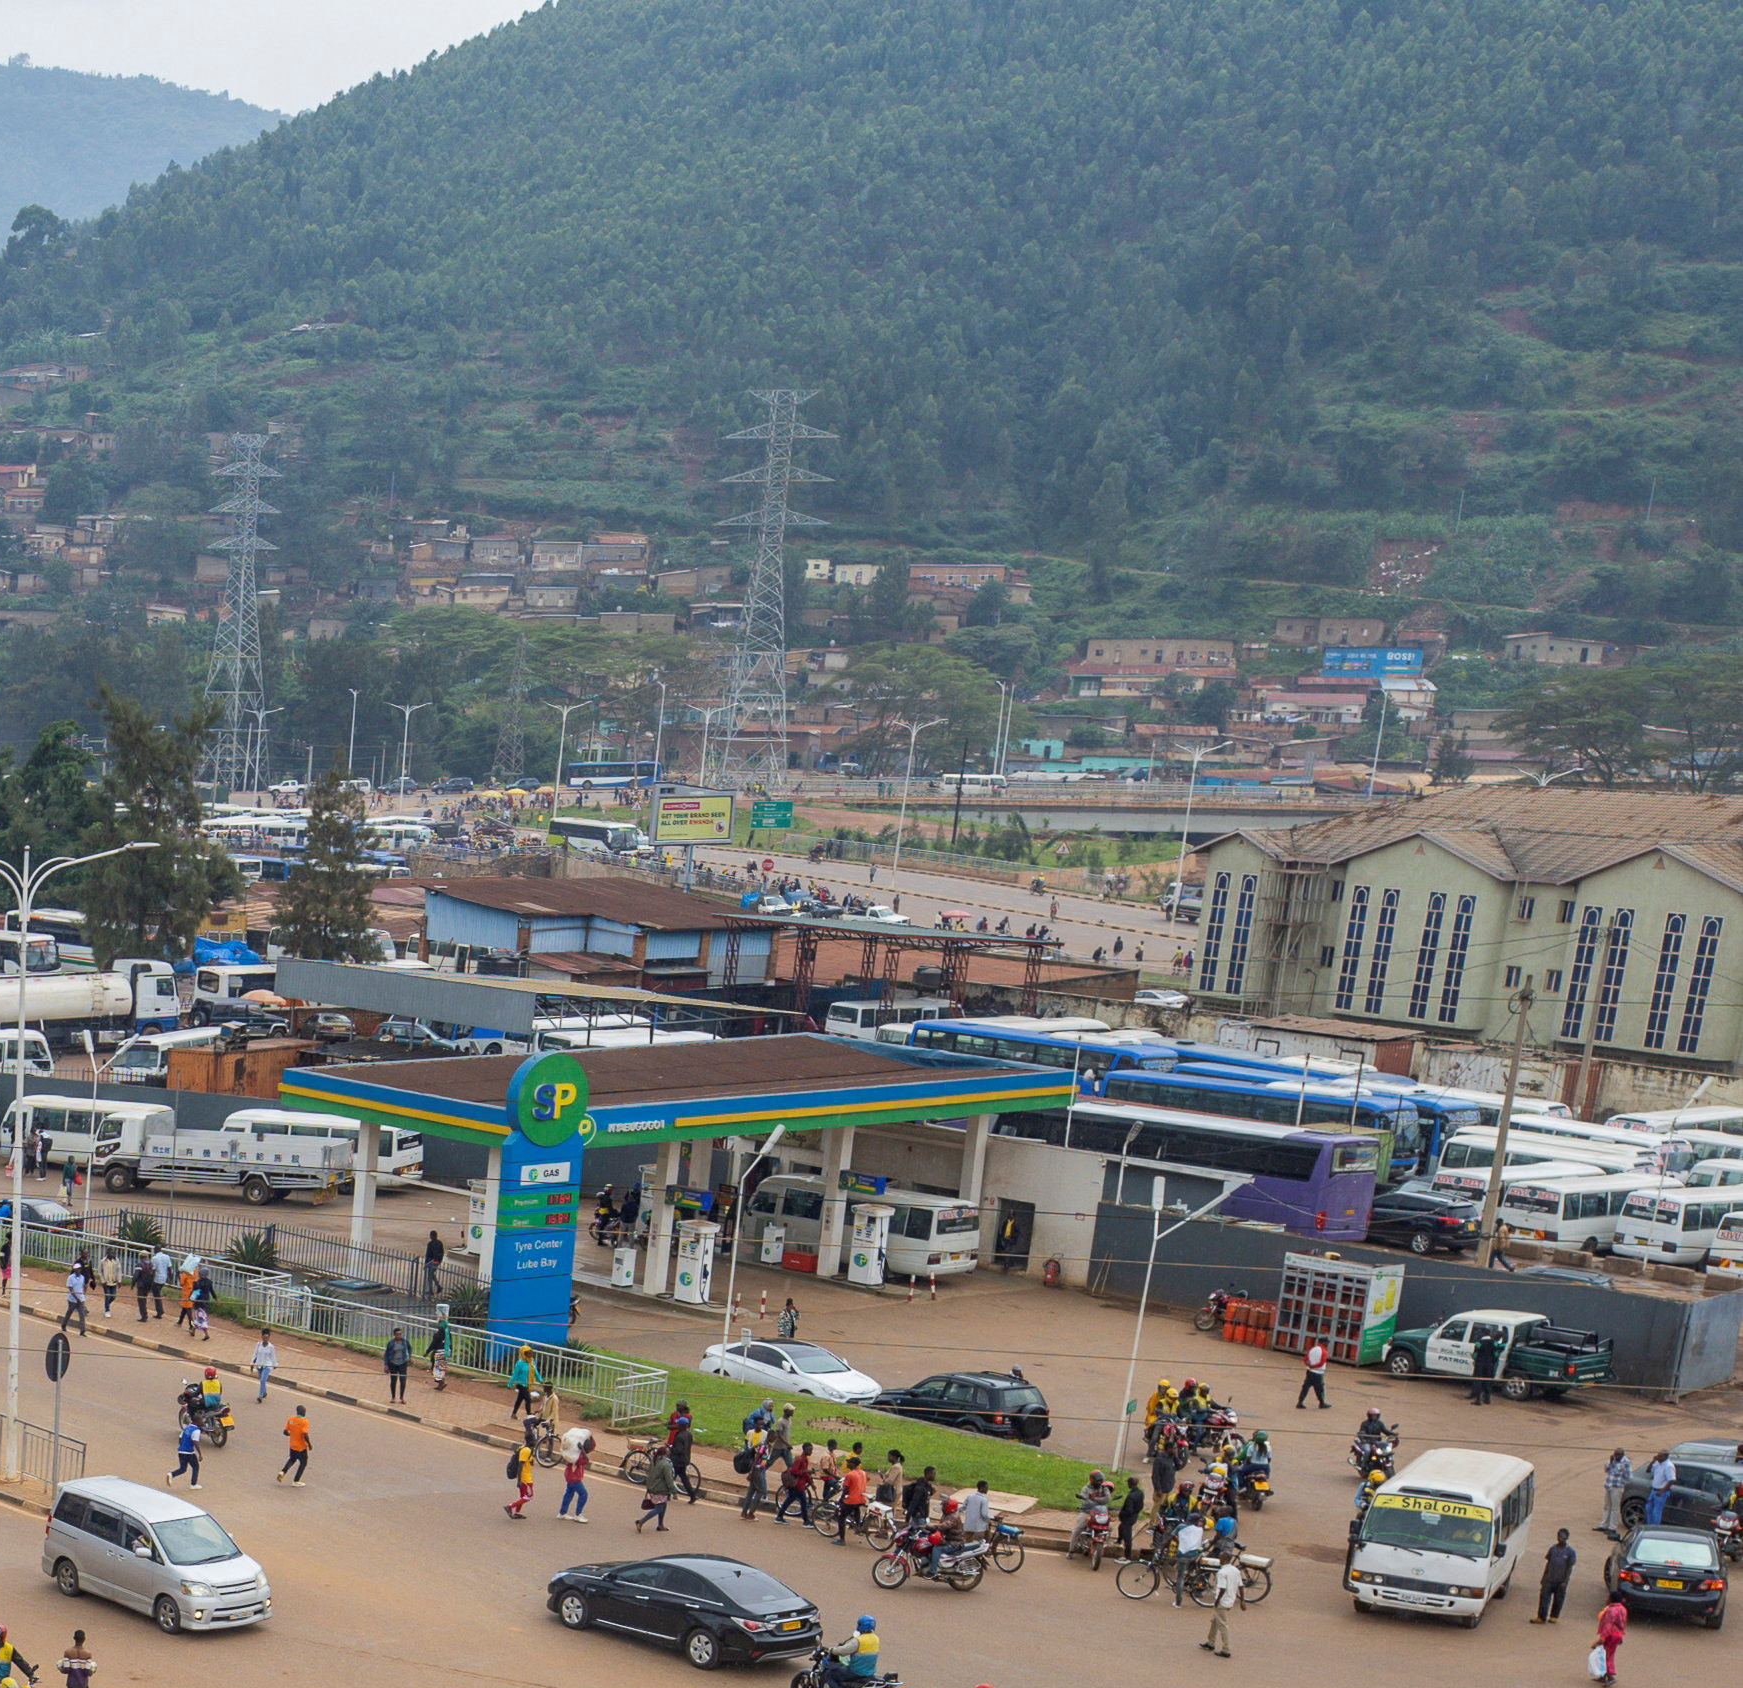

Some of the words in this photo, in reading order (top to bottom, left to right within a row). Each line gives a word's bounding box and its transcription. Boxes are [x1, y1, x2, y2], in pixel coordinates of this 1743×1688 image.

[532, 1083, 577, 1121] SP
[543, 1168, 560, 1178] GAS
[1509, 1186, 1528, 1196] KIVU
[1538, 1191, 1559, 1201] BELT
[1628, 1195, 1647, 1205] KIVU
[515, 1242, 532, 1251] Tyre
[535, 1240, 562, 1250] Center
[517, 1260, 539, 1269] Lube
[541, 1258, 558, 1268] Bay
[1438, 1355, 1470, 1365] PATROL
[1401, 1496, 1468, 1517] Shalom
